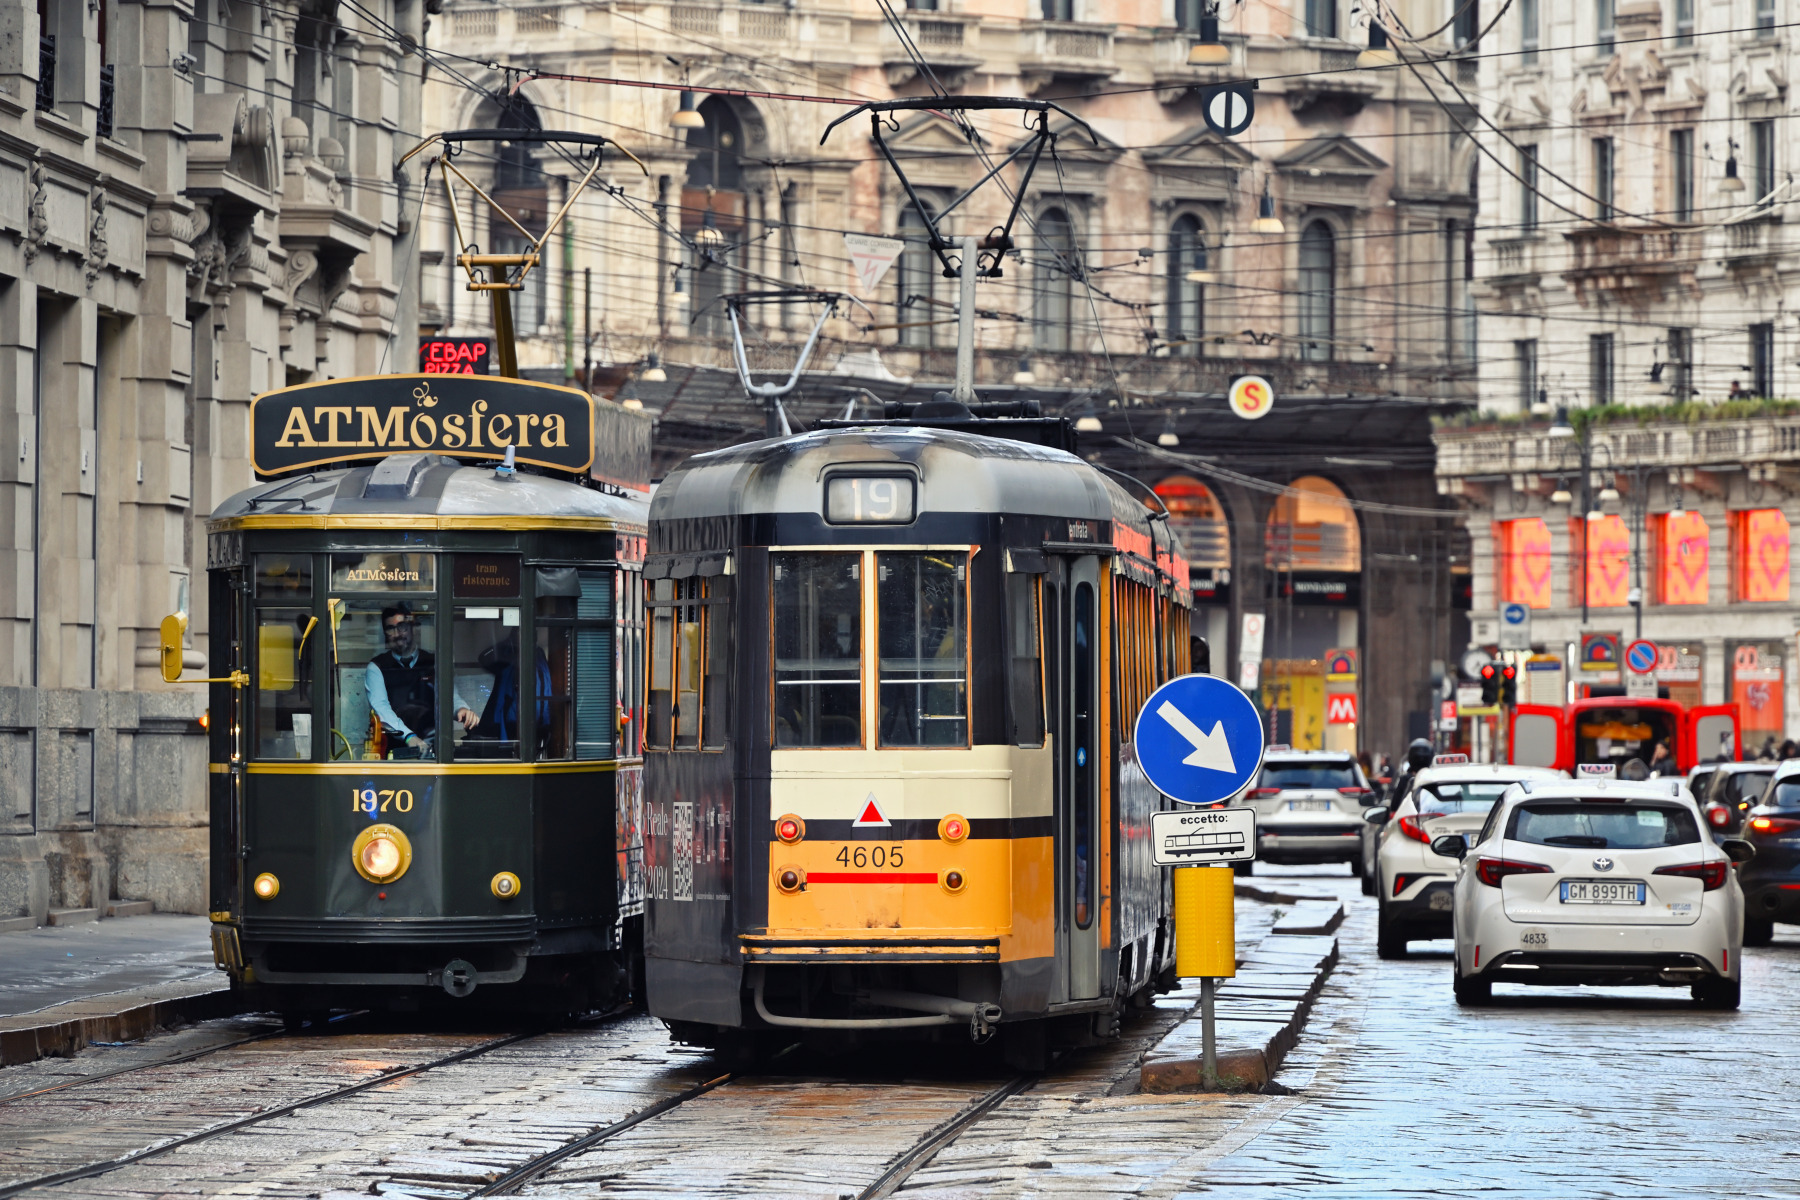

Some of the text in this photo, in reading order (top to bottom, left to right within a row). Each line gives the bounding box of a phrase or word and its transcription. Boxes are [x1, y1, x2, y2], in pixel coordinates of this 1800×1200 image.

[424, 362, 475, 375] PIZZA
[1243, 383, 1260, 411] S
[275, 399, 570, 448] ATMosfera
[851, 478, 898, 521] 19
[1068, 521, 1088, 540] entrata
[346, 568, 420, 581] ATMosfera
[475, 563, 498, 573] tram
[462, 575, 510, 586] ristorante
[1329, 697, 1356, 720] M
[1436, 755, 1466, 764] TAXI
[1583, 765, 1612, 774] TAXI
[352, 789, 414, 812] 1970
[646, 801, 668, 835] Reale
[1180, 813, 1229, 825] eccetto:
[836, 845, 904, 868] 4605
[1569, 884, 1636, 900] GM 899TH
[1523, 932, 1547, 944] 4833
